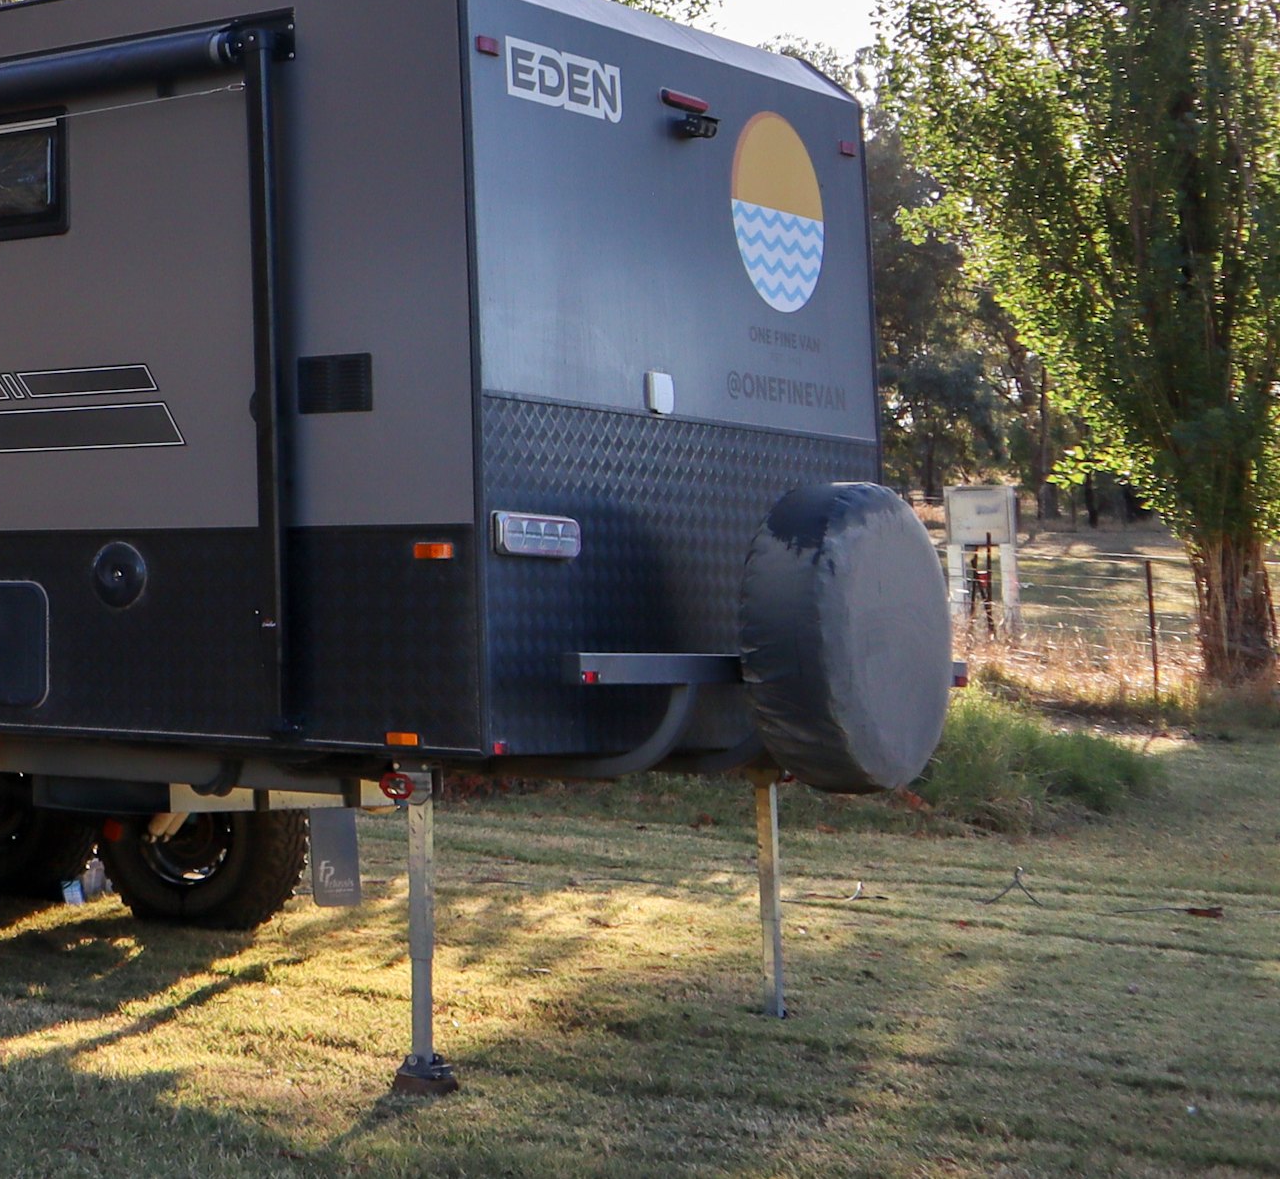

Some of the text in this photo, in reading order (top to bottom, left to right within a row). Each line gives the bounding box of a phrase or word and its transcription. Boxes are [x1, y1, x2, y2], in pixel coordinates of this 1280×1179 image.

[506, 36, 622, 123] EDEN
[749, 325, 820, 353] ONE FINE VAN
[727, 370, 847, 411] @ONEFINEVAN
